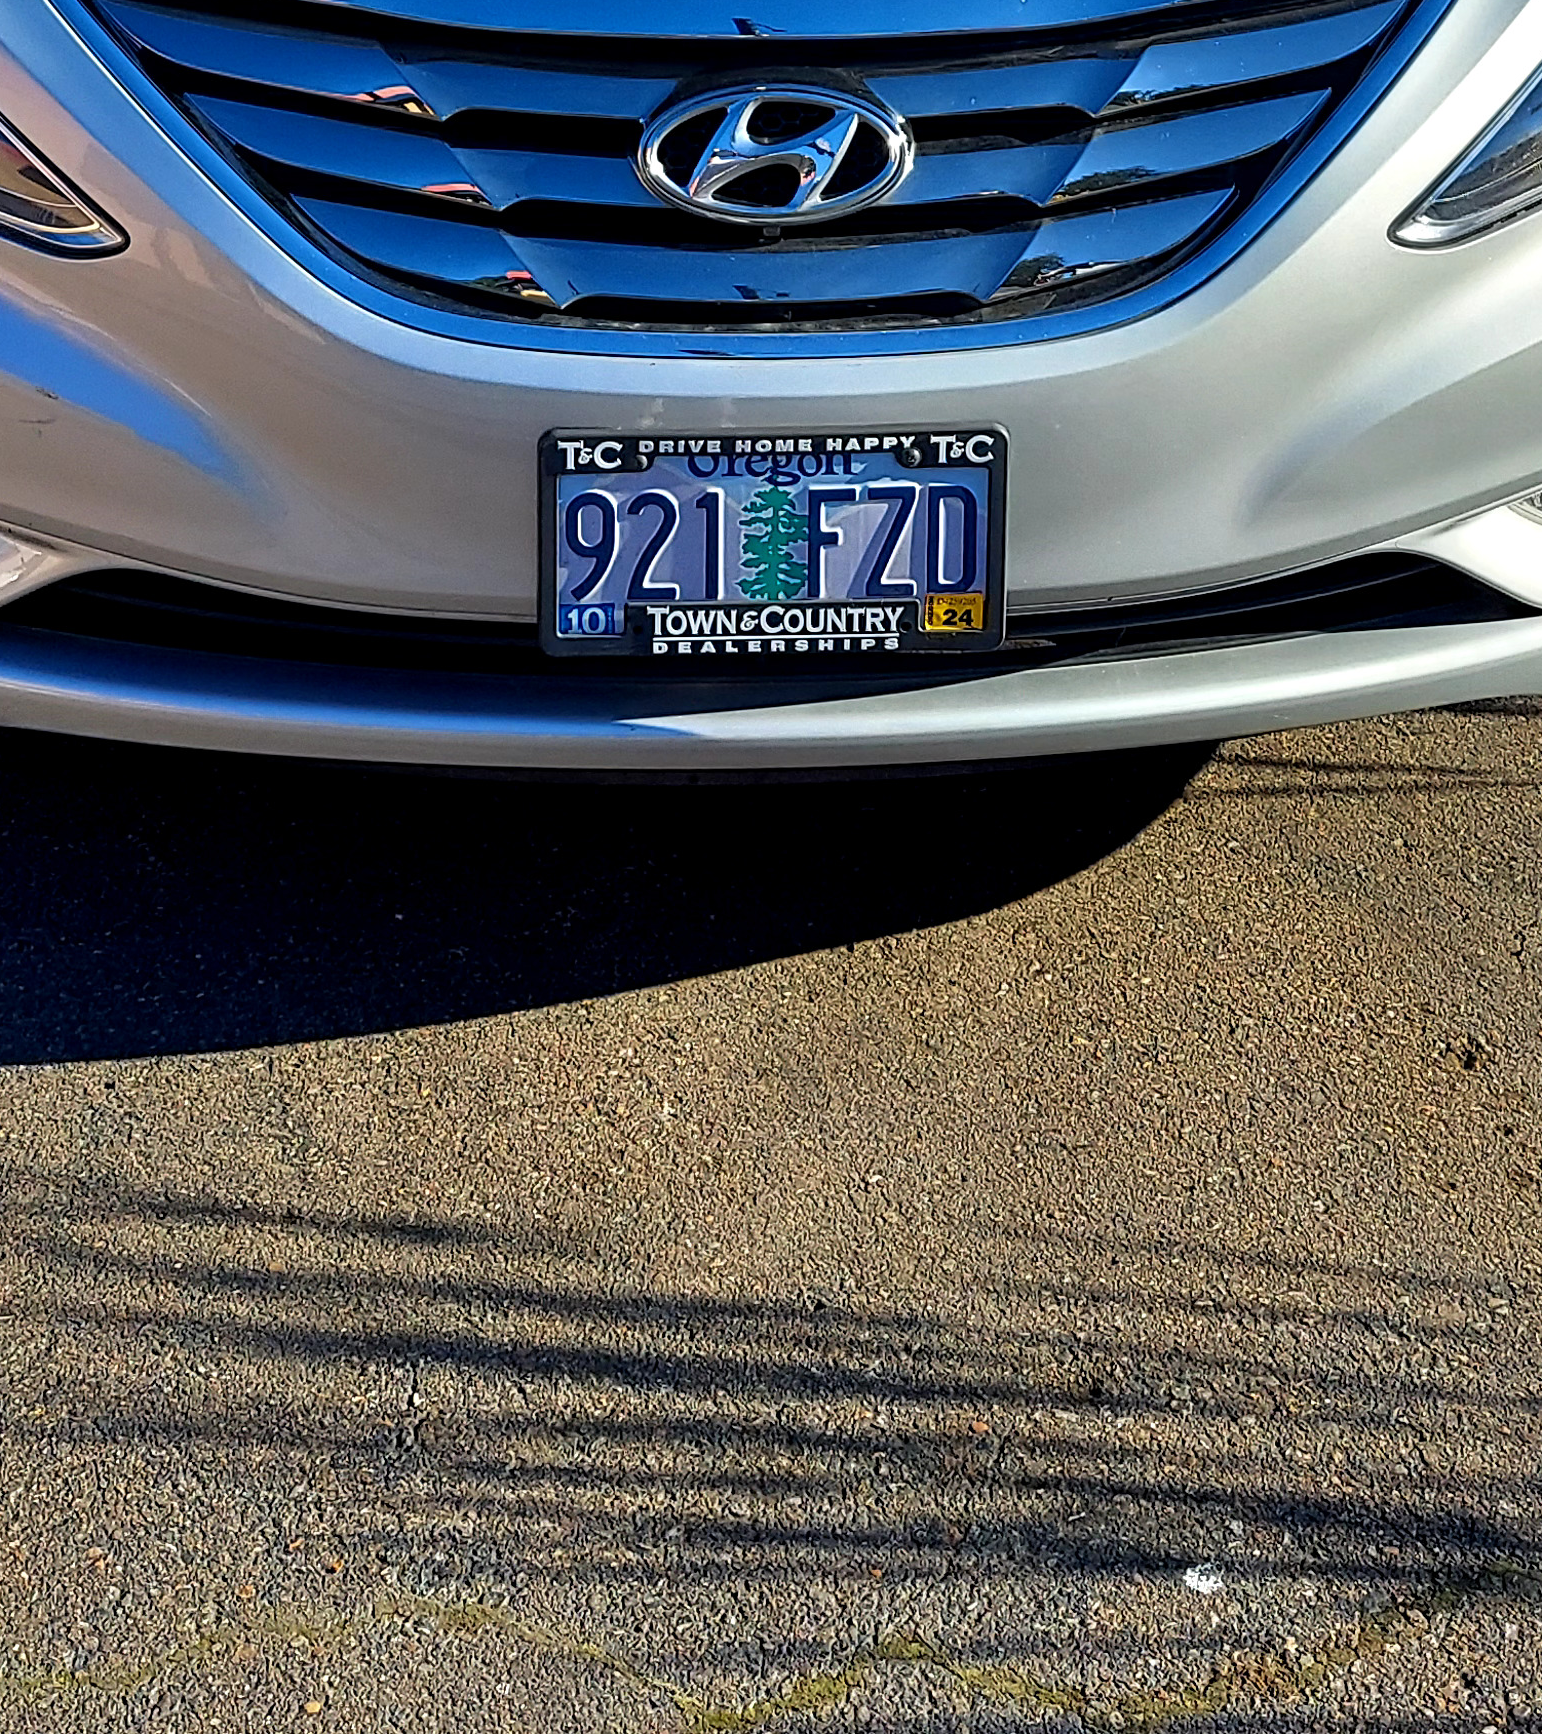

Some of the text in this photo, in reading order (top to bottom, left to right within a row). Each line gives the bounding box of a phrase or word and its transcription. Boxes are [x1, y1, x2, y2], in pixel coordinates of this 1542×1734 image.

[558, 434, 995, 471] T&C DRIVE HOME HAPPY T&C
[564, 482, 980, 601] 921 FZD
[566, 609, 607, 635] 10
[942, 608, 974, 627] 24
[652, 638, 900, 655] DEALERSHIPS
